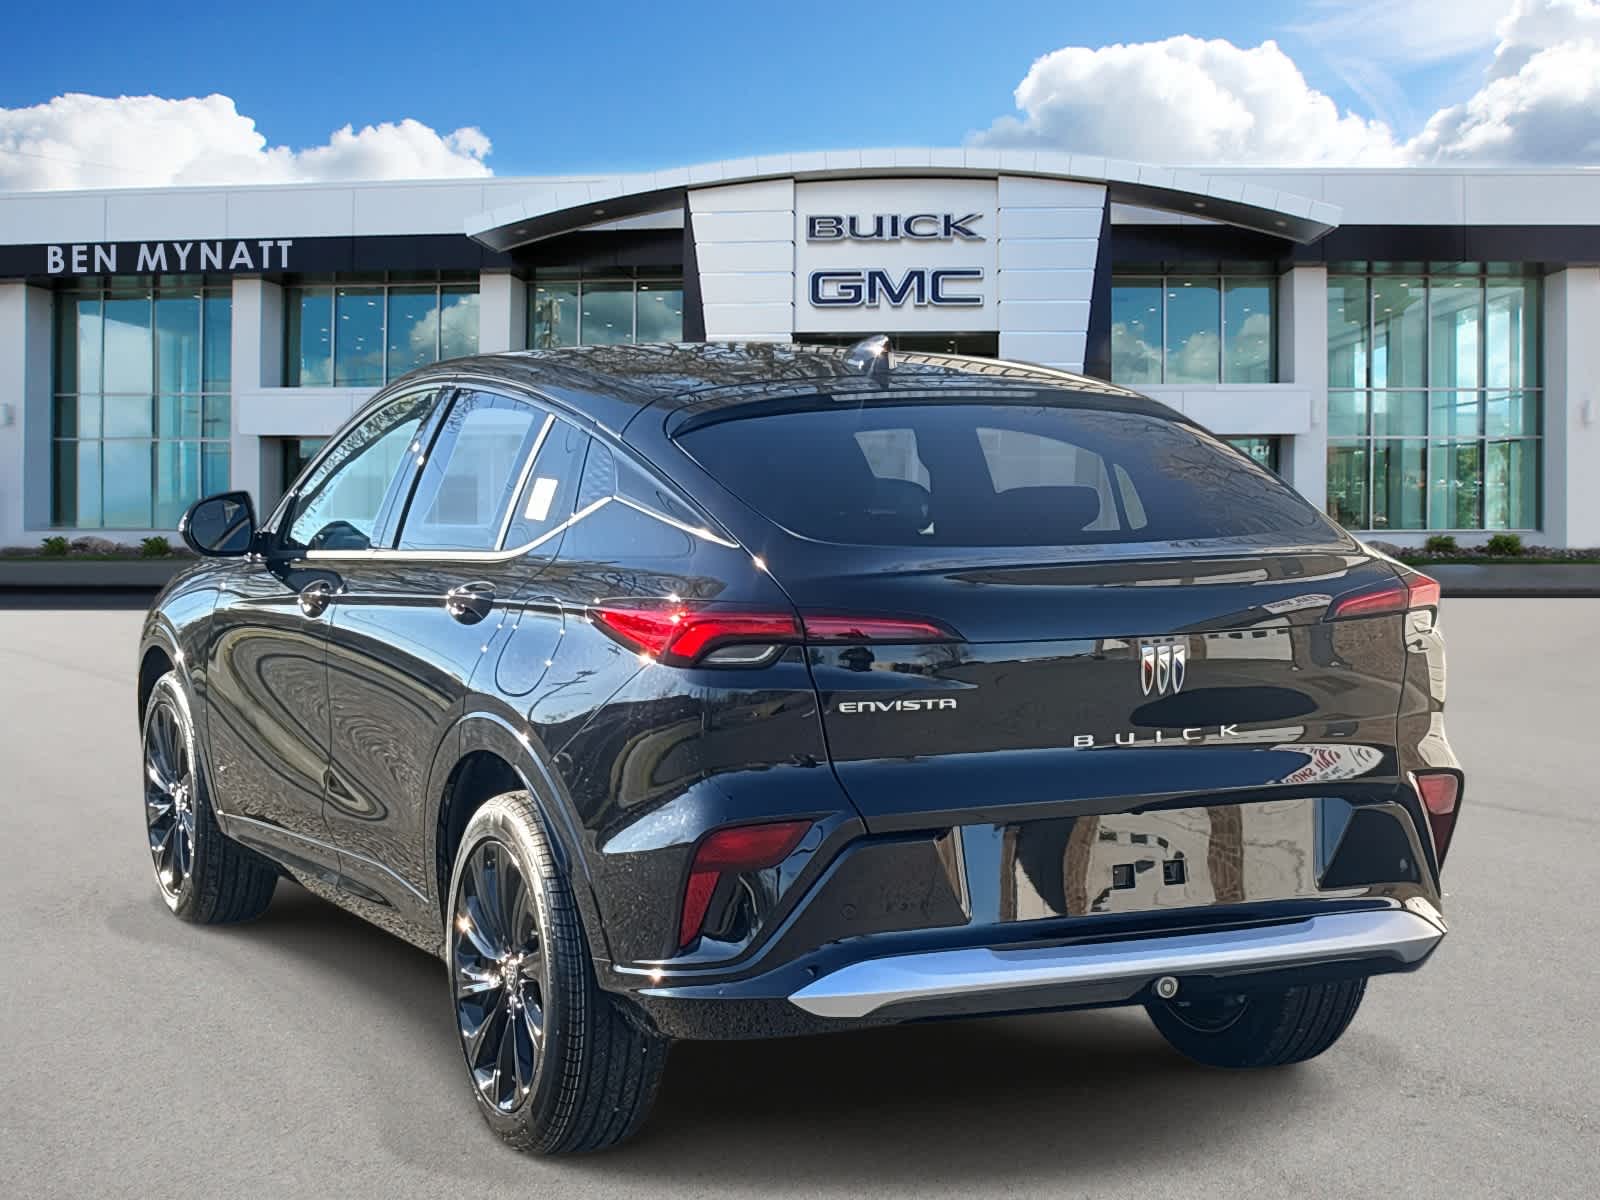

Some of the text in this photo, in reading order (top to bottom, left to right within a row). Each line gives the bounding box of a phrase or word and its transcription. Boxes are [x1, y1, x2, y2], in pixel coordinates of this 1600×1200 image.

[807, 213, 985, 242] BUICK
[47, 240, 293, 274] BEN MYNATT
[809, 268, 985, 309] GMC
[839, 698, 957, 713] ENVISTA
[1073, 723, 1240, 748] BUICK
